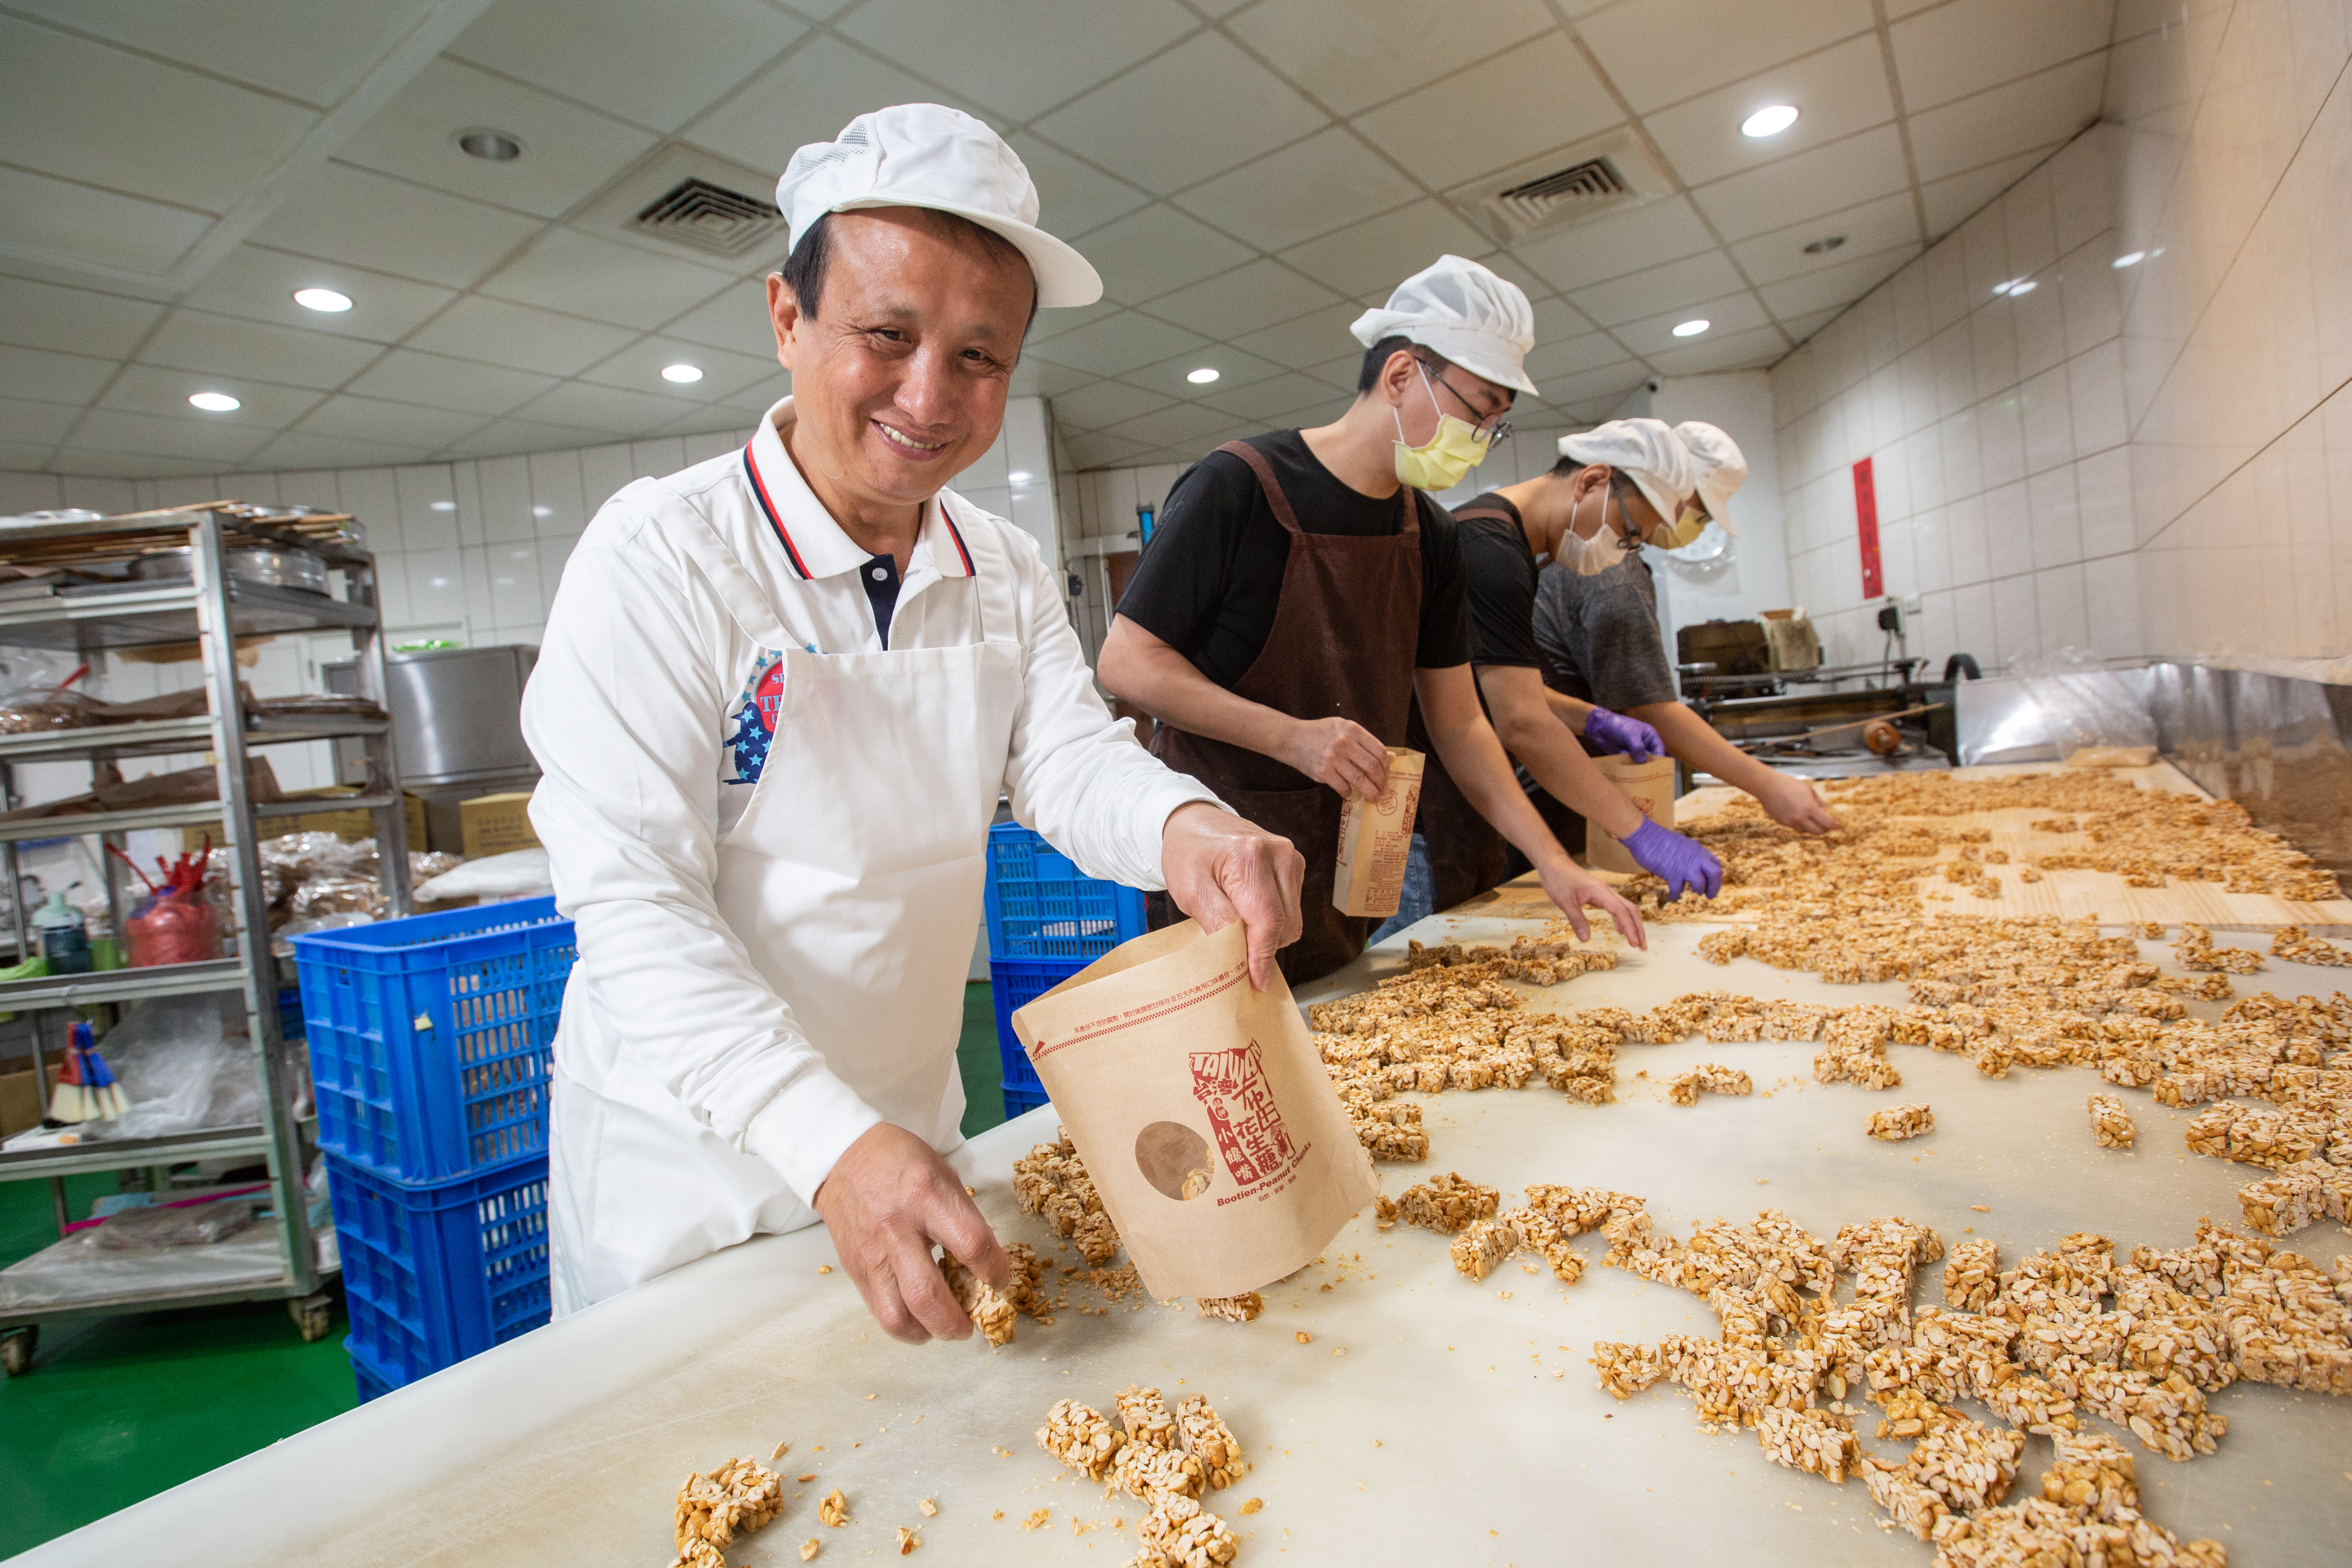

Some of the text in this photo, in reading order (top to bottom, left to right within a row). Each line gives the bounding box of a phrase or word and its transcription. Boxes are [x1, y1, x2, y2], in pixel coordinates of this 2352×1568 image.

[1190, 1038, 1261, 1085] TAIWAN
[1233, 1116, 1279, 1175] 花生糖
[1292, 1141, 1312, 1168] Chunks
